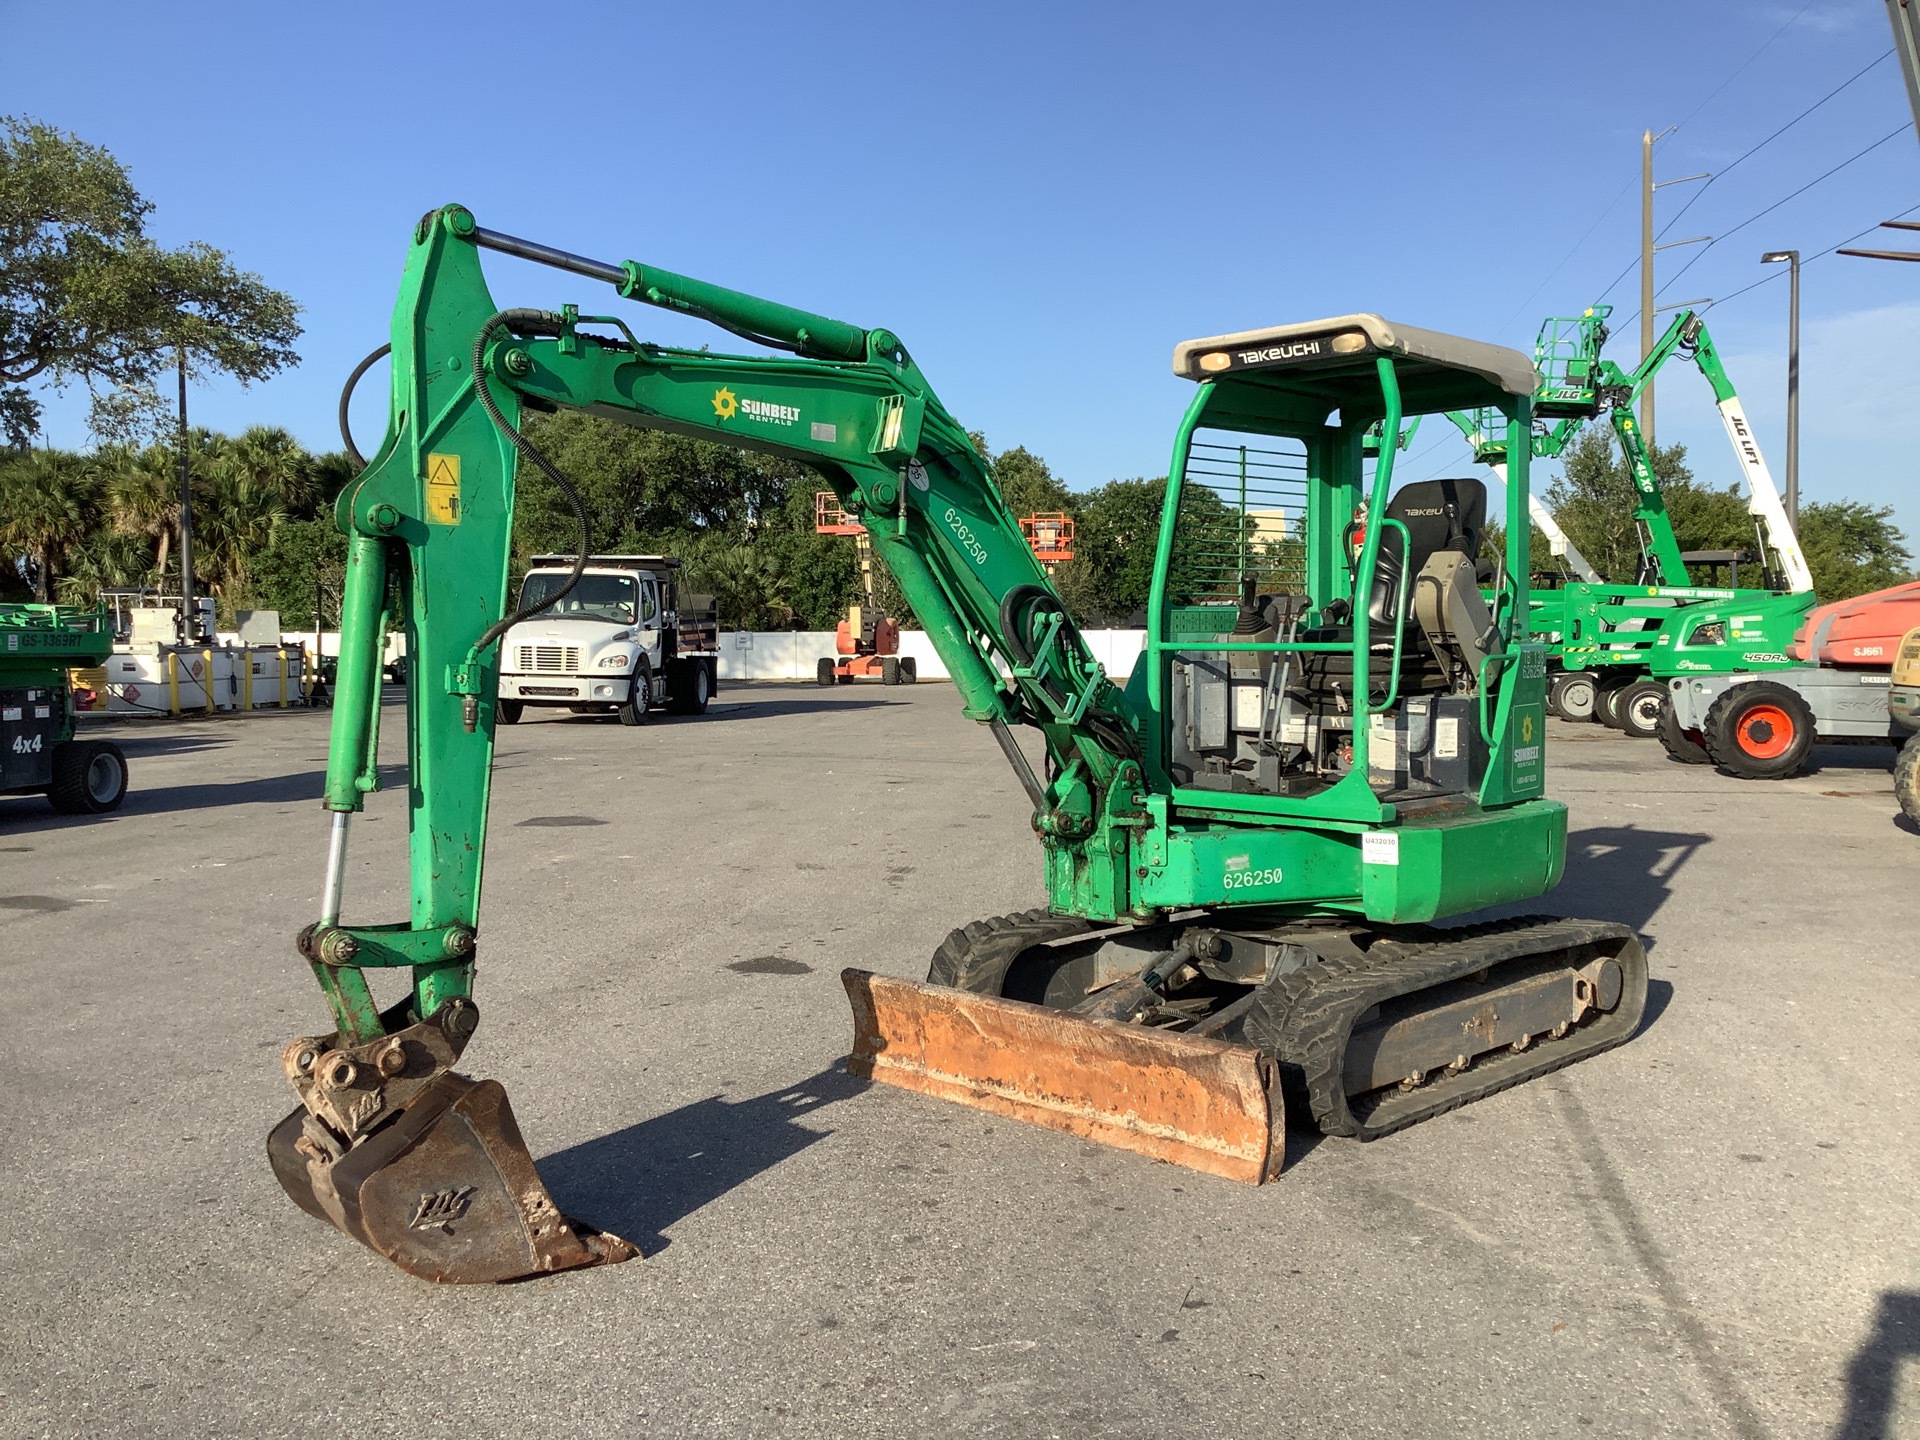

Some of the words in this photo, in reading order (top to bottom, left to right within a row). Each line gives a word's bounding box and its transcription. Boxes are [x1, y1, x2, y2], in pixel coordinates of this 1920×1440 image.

[1238, 342, 1320, 364] TAKEUCHI
[1554, 390, 1581, 400] JLG
[741, 399, 801, 421] SUNBELT
[749, 414, 792, 426] RENTALS
[1731, 416, 1748, 436] JLG
[1741, 440, 1760, 465] LIFT
[944, 508, 988, 565] 626250
[1853, 646, 1883, 657] SJ661
[12, 734, 43, 754] 4x4
[1514, 746, 1539, 763] SUNBELT
[1223, 868, 1283, 889] 626250
